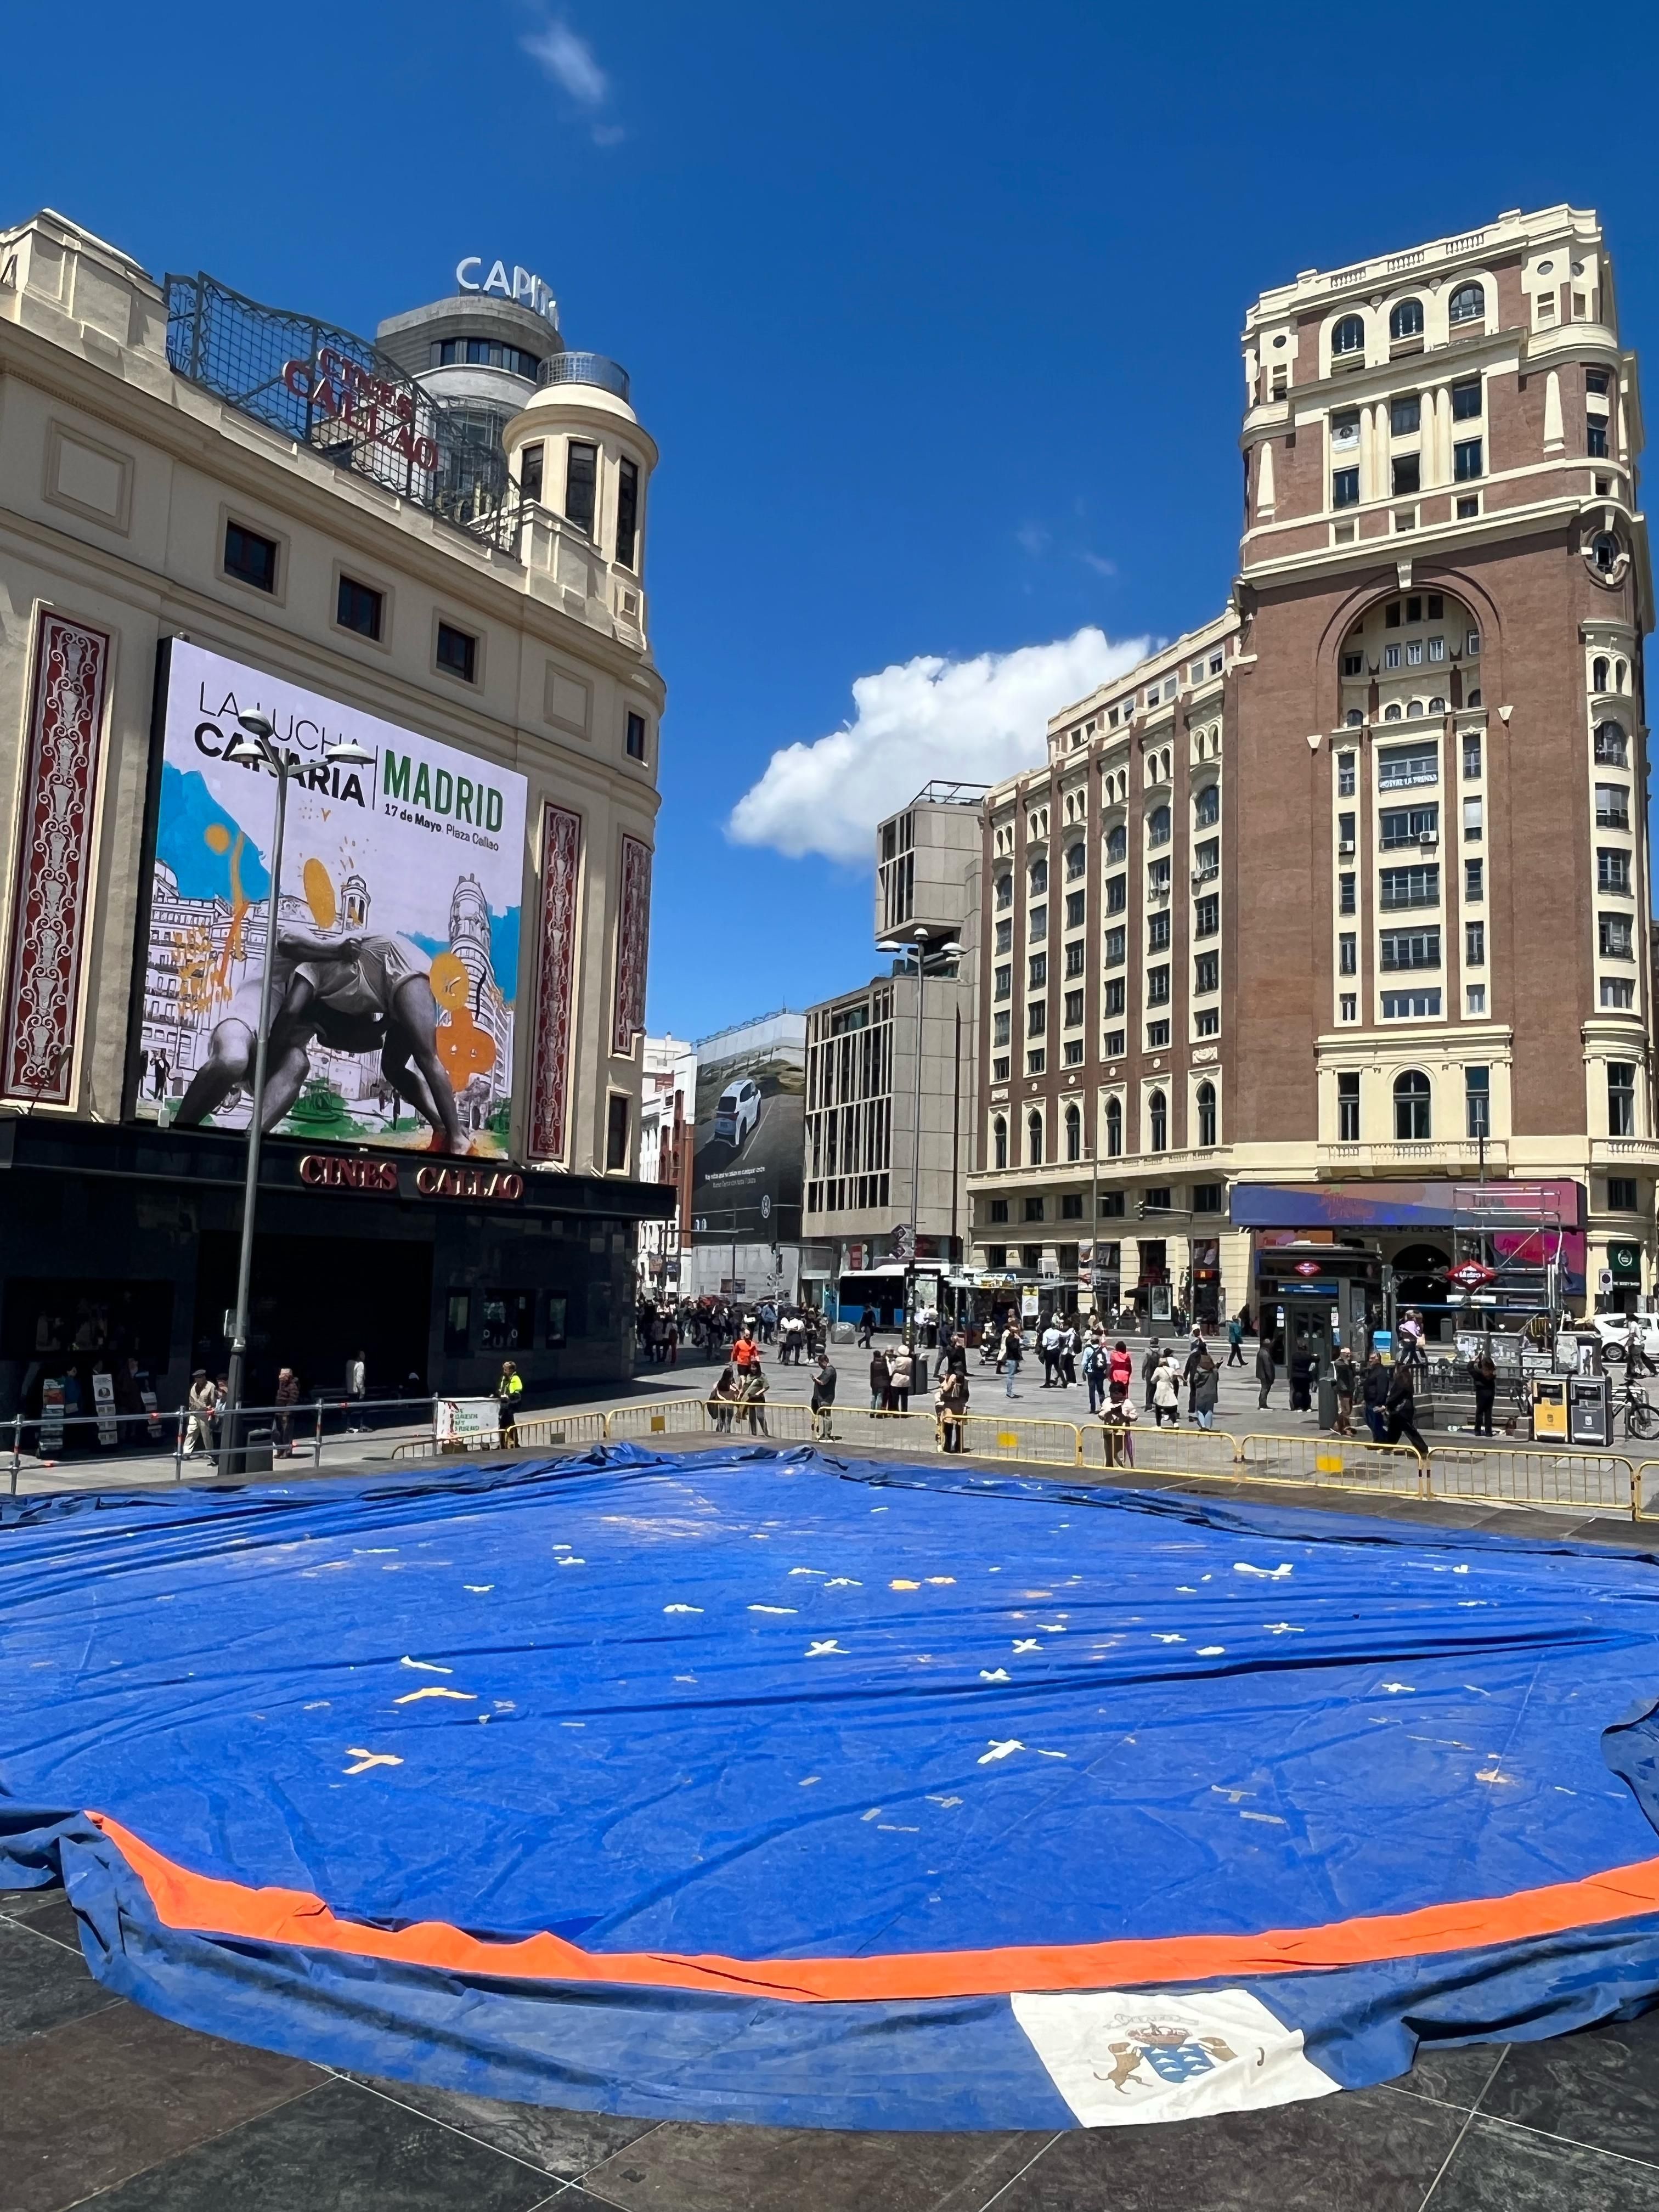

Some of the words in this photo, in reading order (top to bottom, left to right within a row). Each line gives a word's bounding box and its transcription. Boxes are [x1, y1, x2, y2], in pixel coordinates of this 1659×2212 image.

[456, 257, 558, 330] CAPIT
[282, 360, 438, 471] CALLAO
[318, 348, 413, 421] CINES
[200, 681, 239, 717] LA
[257, 702, 364, 769] UCH
[383, 749, 503, 832] MADRID
[385, 803, 398, 817] 17
[400, 809, 413, 822] de
[446, 823, 470, 842] Plaza
[472, 832, 499, 851] Callao
[300, 1155, 398, 1190] CINES
[416, 1167, 523, 1199] CALLAO
